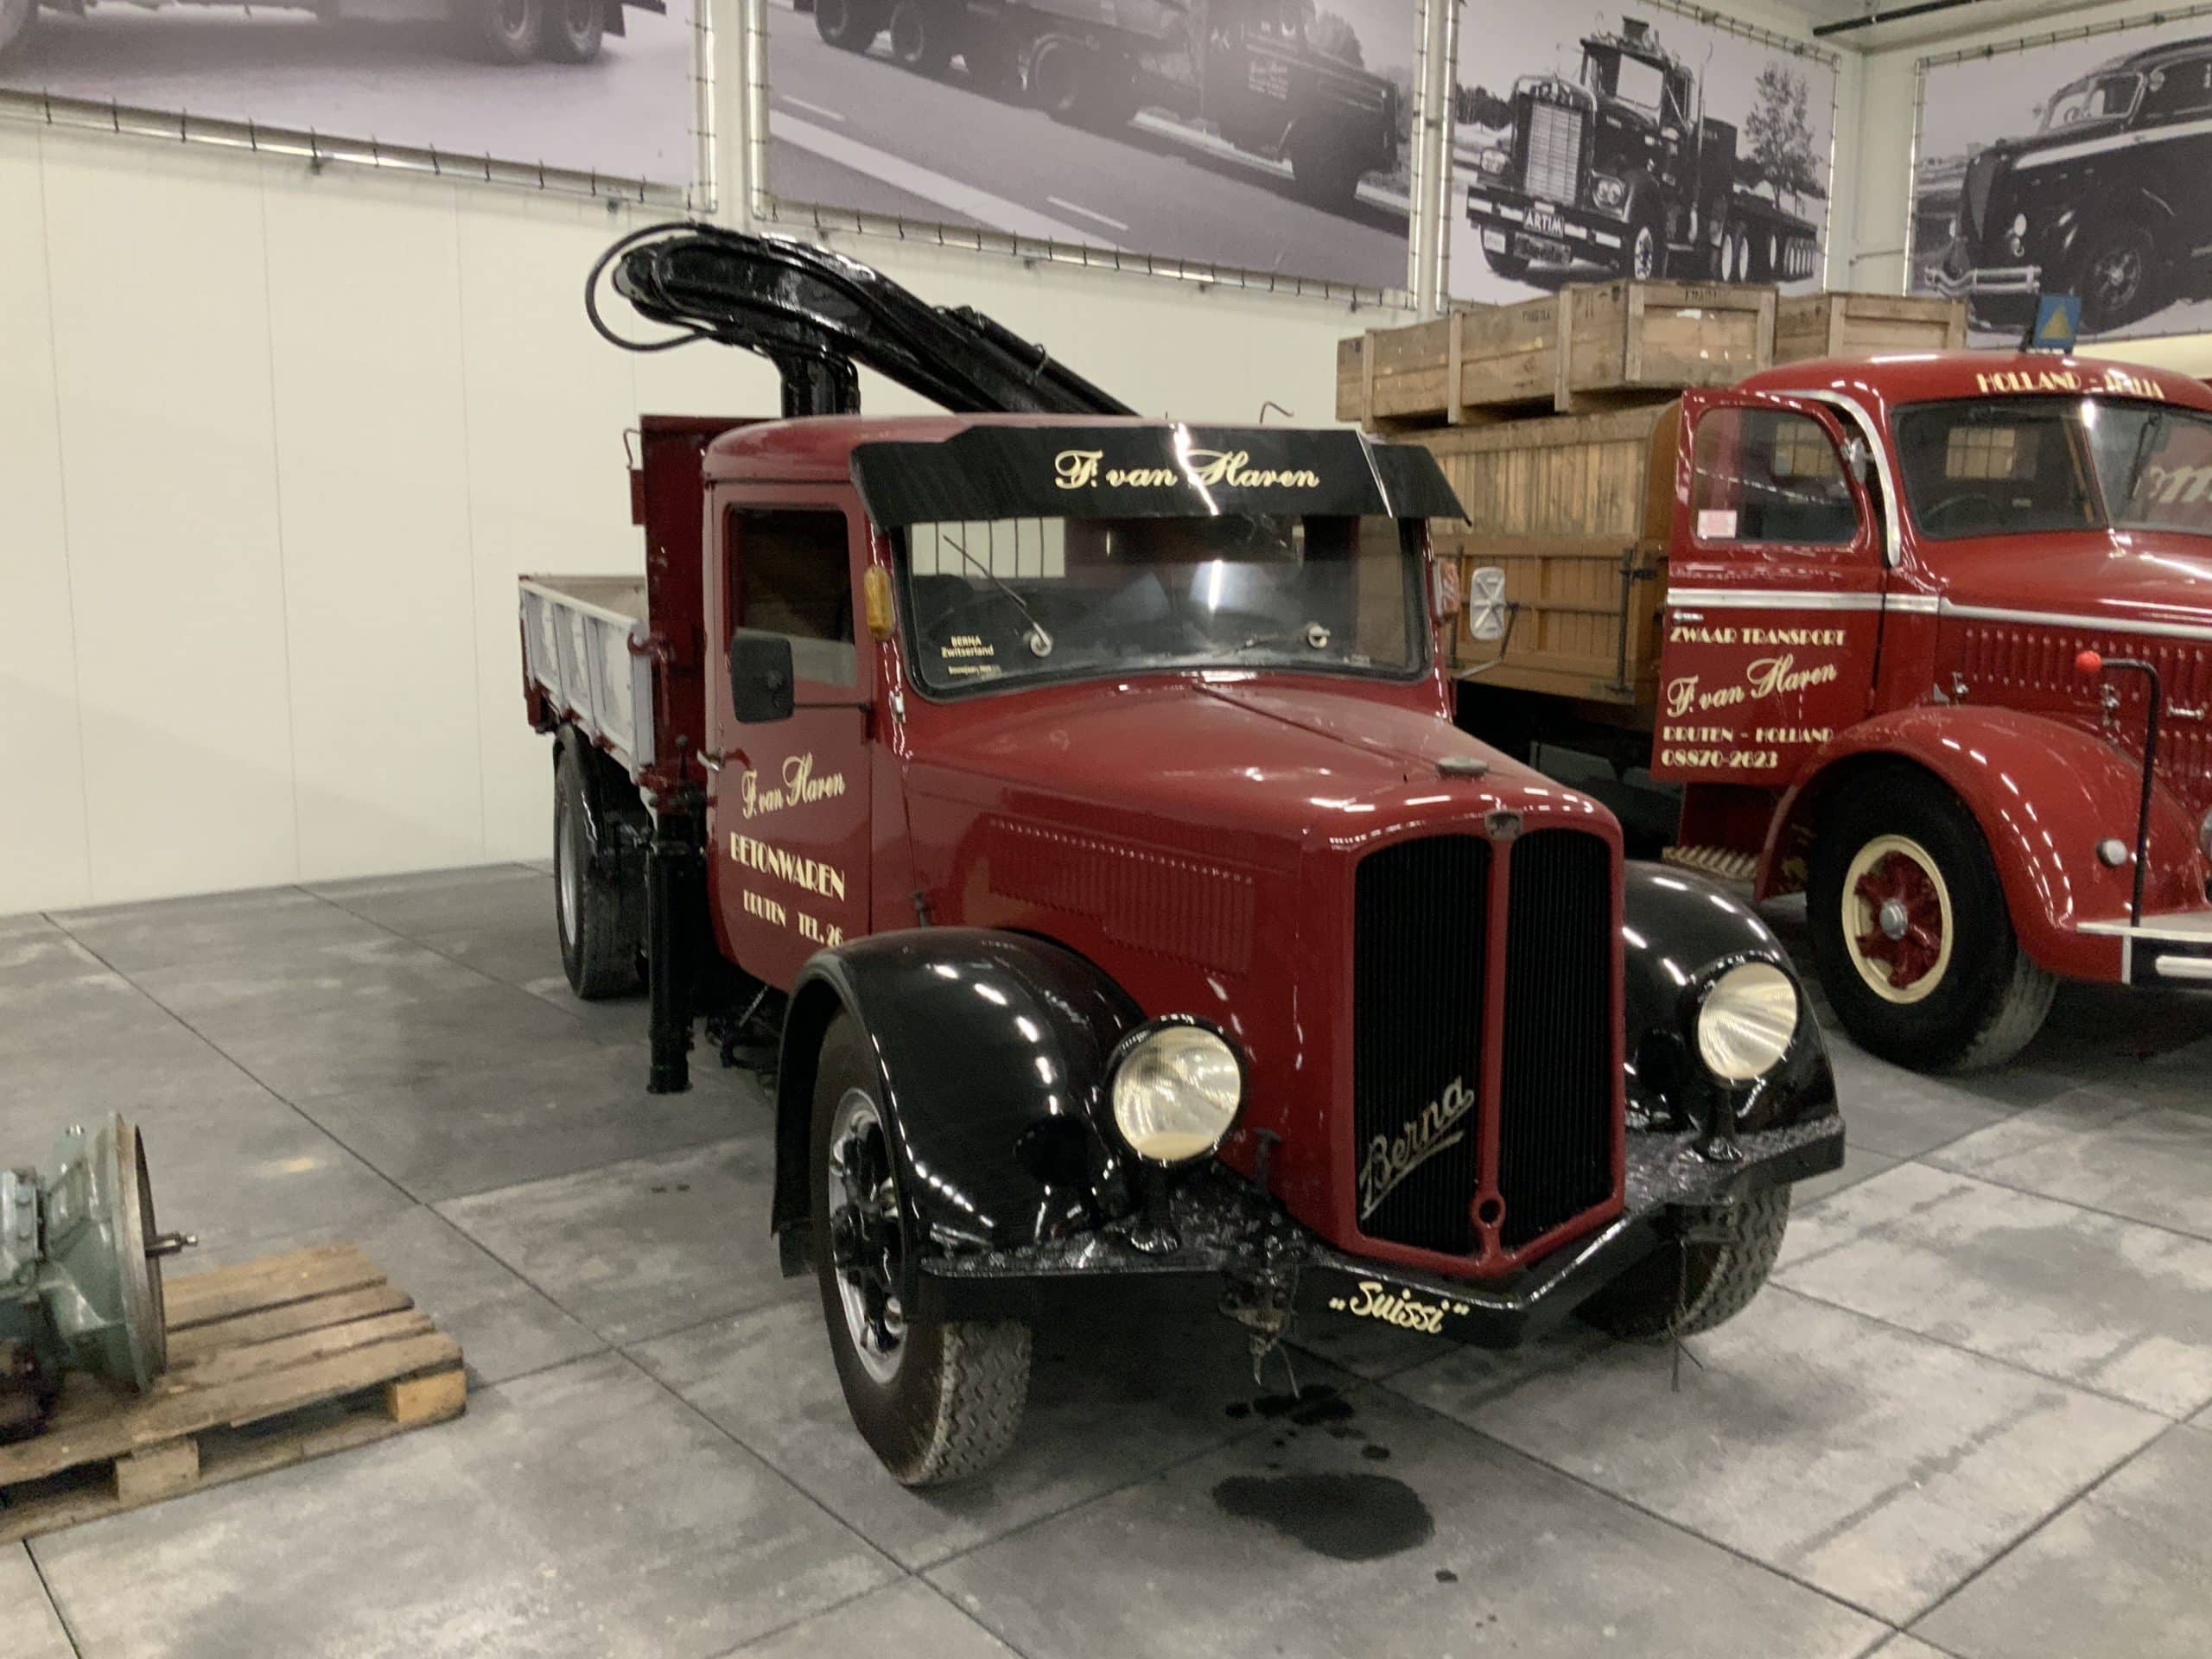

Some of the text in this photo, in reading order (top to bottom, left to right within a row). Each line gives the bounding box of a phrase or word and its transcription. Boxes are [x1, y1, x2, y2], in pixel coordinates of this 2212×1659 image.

[1976, 372, 2082, 393] HOLLAND
[1105, 467, 1178, 488] van
[1183, 448, 1320, 488] Haren
[950, 635, 982, 648] BERNA
[1669, 626, 1847, 646] ZWAAR TRANSPORT
[1698, 684, 1745, 711] van
[1746, 653, 1838, 699] Haren
[1662, 726, 1734, 743] DRUTEN
[1755, 728, 1835, 743] HOLLAND
[758, 787, 785, 814] van
[782, 751, 846, 807] Haren
[729, 830, 845, 902] BETONWAREN
[742, 888, 787, 928] DRUTEN
[1358, 1075, 1475, 1220] Berna
